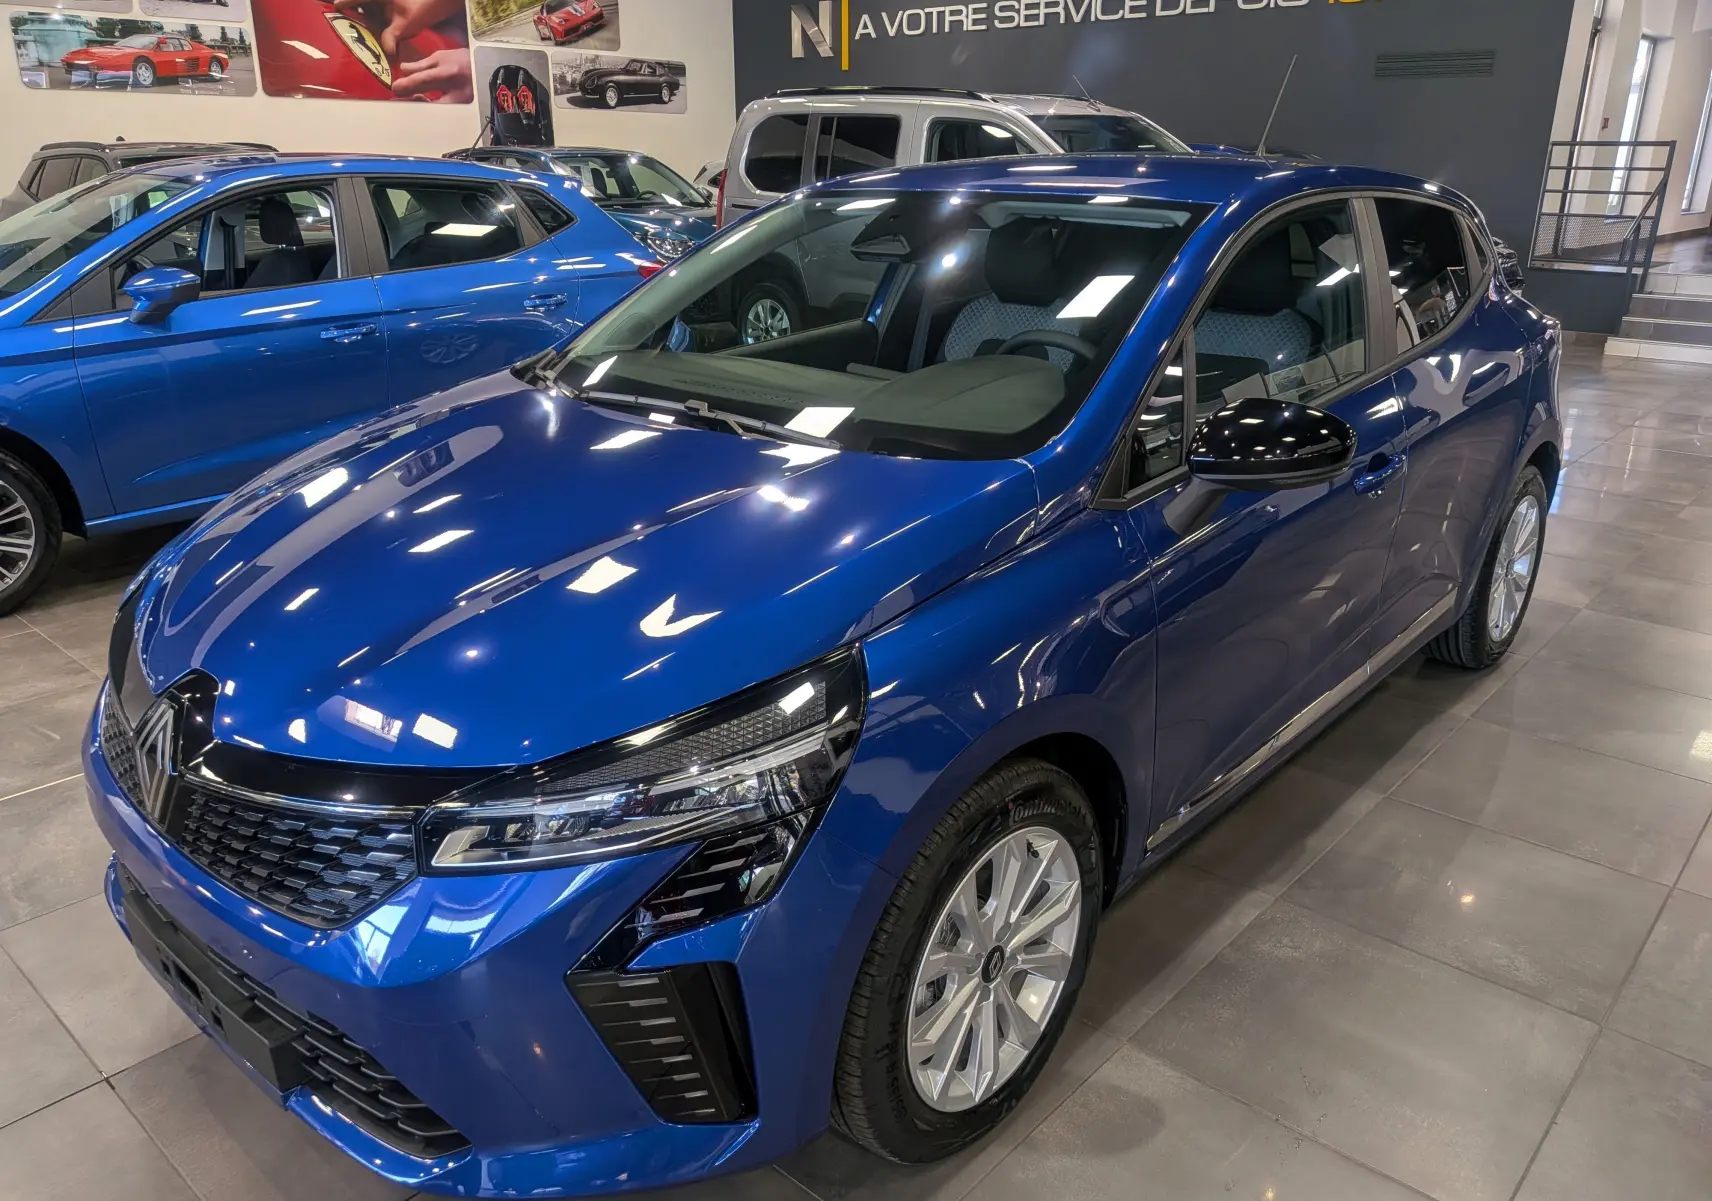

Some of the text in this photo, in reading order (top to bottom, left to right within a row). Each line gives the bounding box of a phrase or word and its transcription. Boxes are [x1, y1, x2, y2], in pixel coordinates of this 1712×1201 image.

[854, 14, 877, 40] A
[881, 3, 988, 37] VOTRE
[994, 0, 1147, 29] SERVICE
